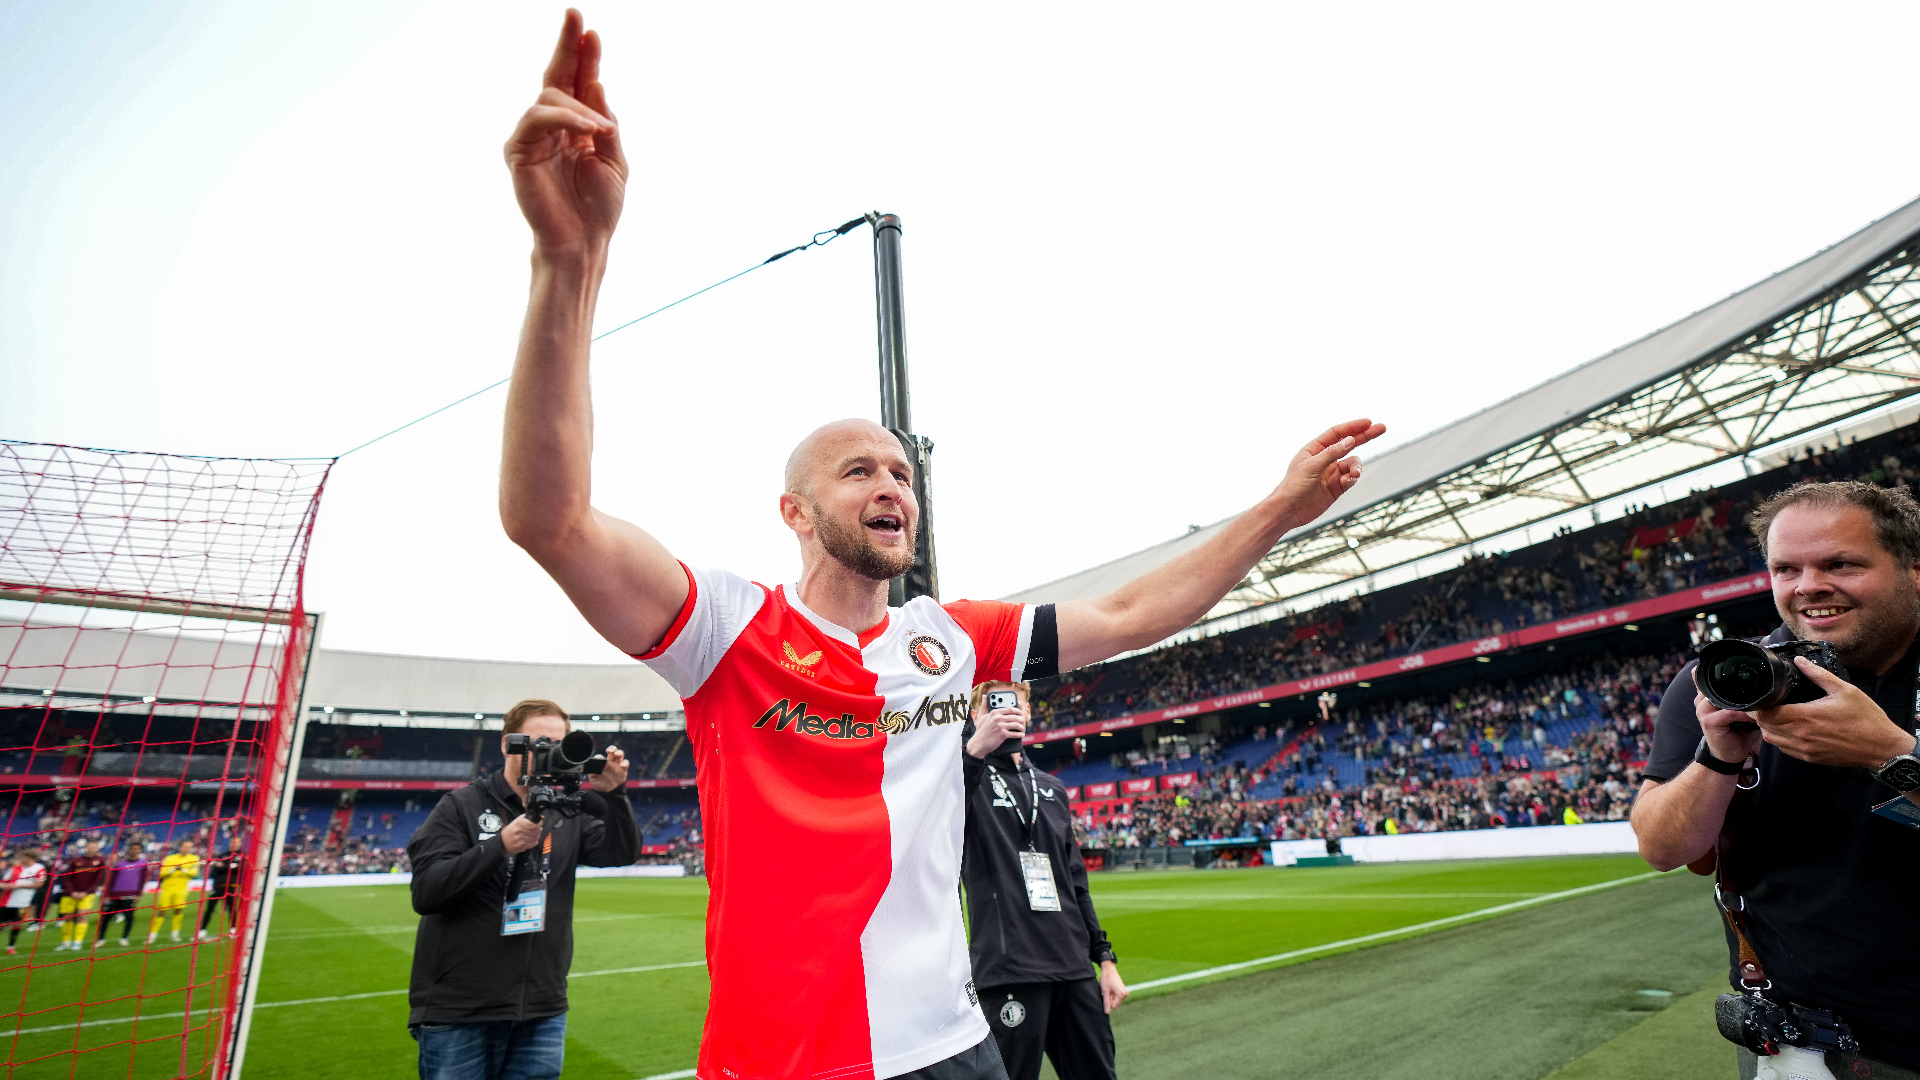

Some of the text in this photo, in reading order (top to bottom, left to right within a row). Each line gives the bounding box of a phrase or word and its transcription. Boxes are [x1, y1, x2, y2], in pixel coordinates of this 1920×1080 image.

[781, 660, 816, 678] CASTORE
[752, 693, 968, 739] Media Markt
